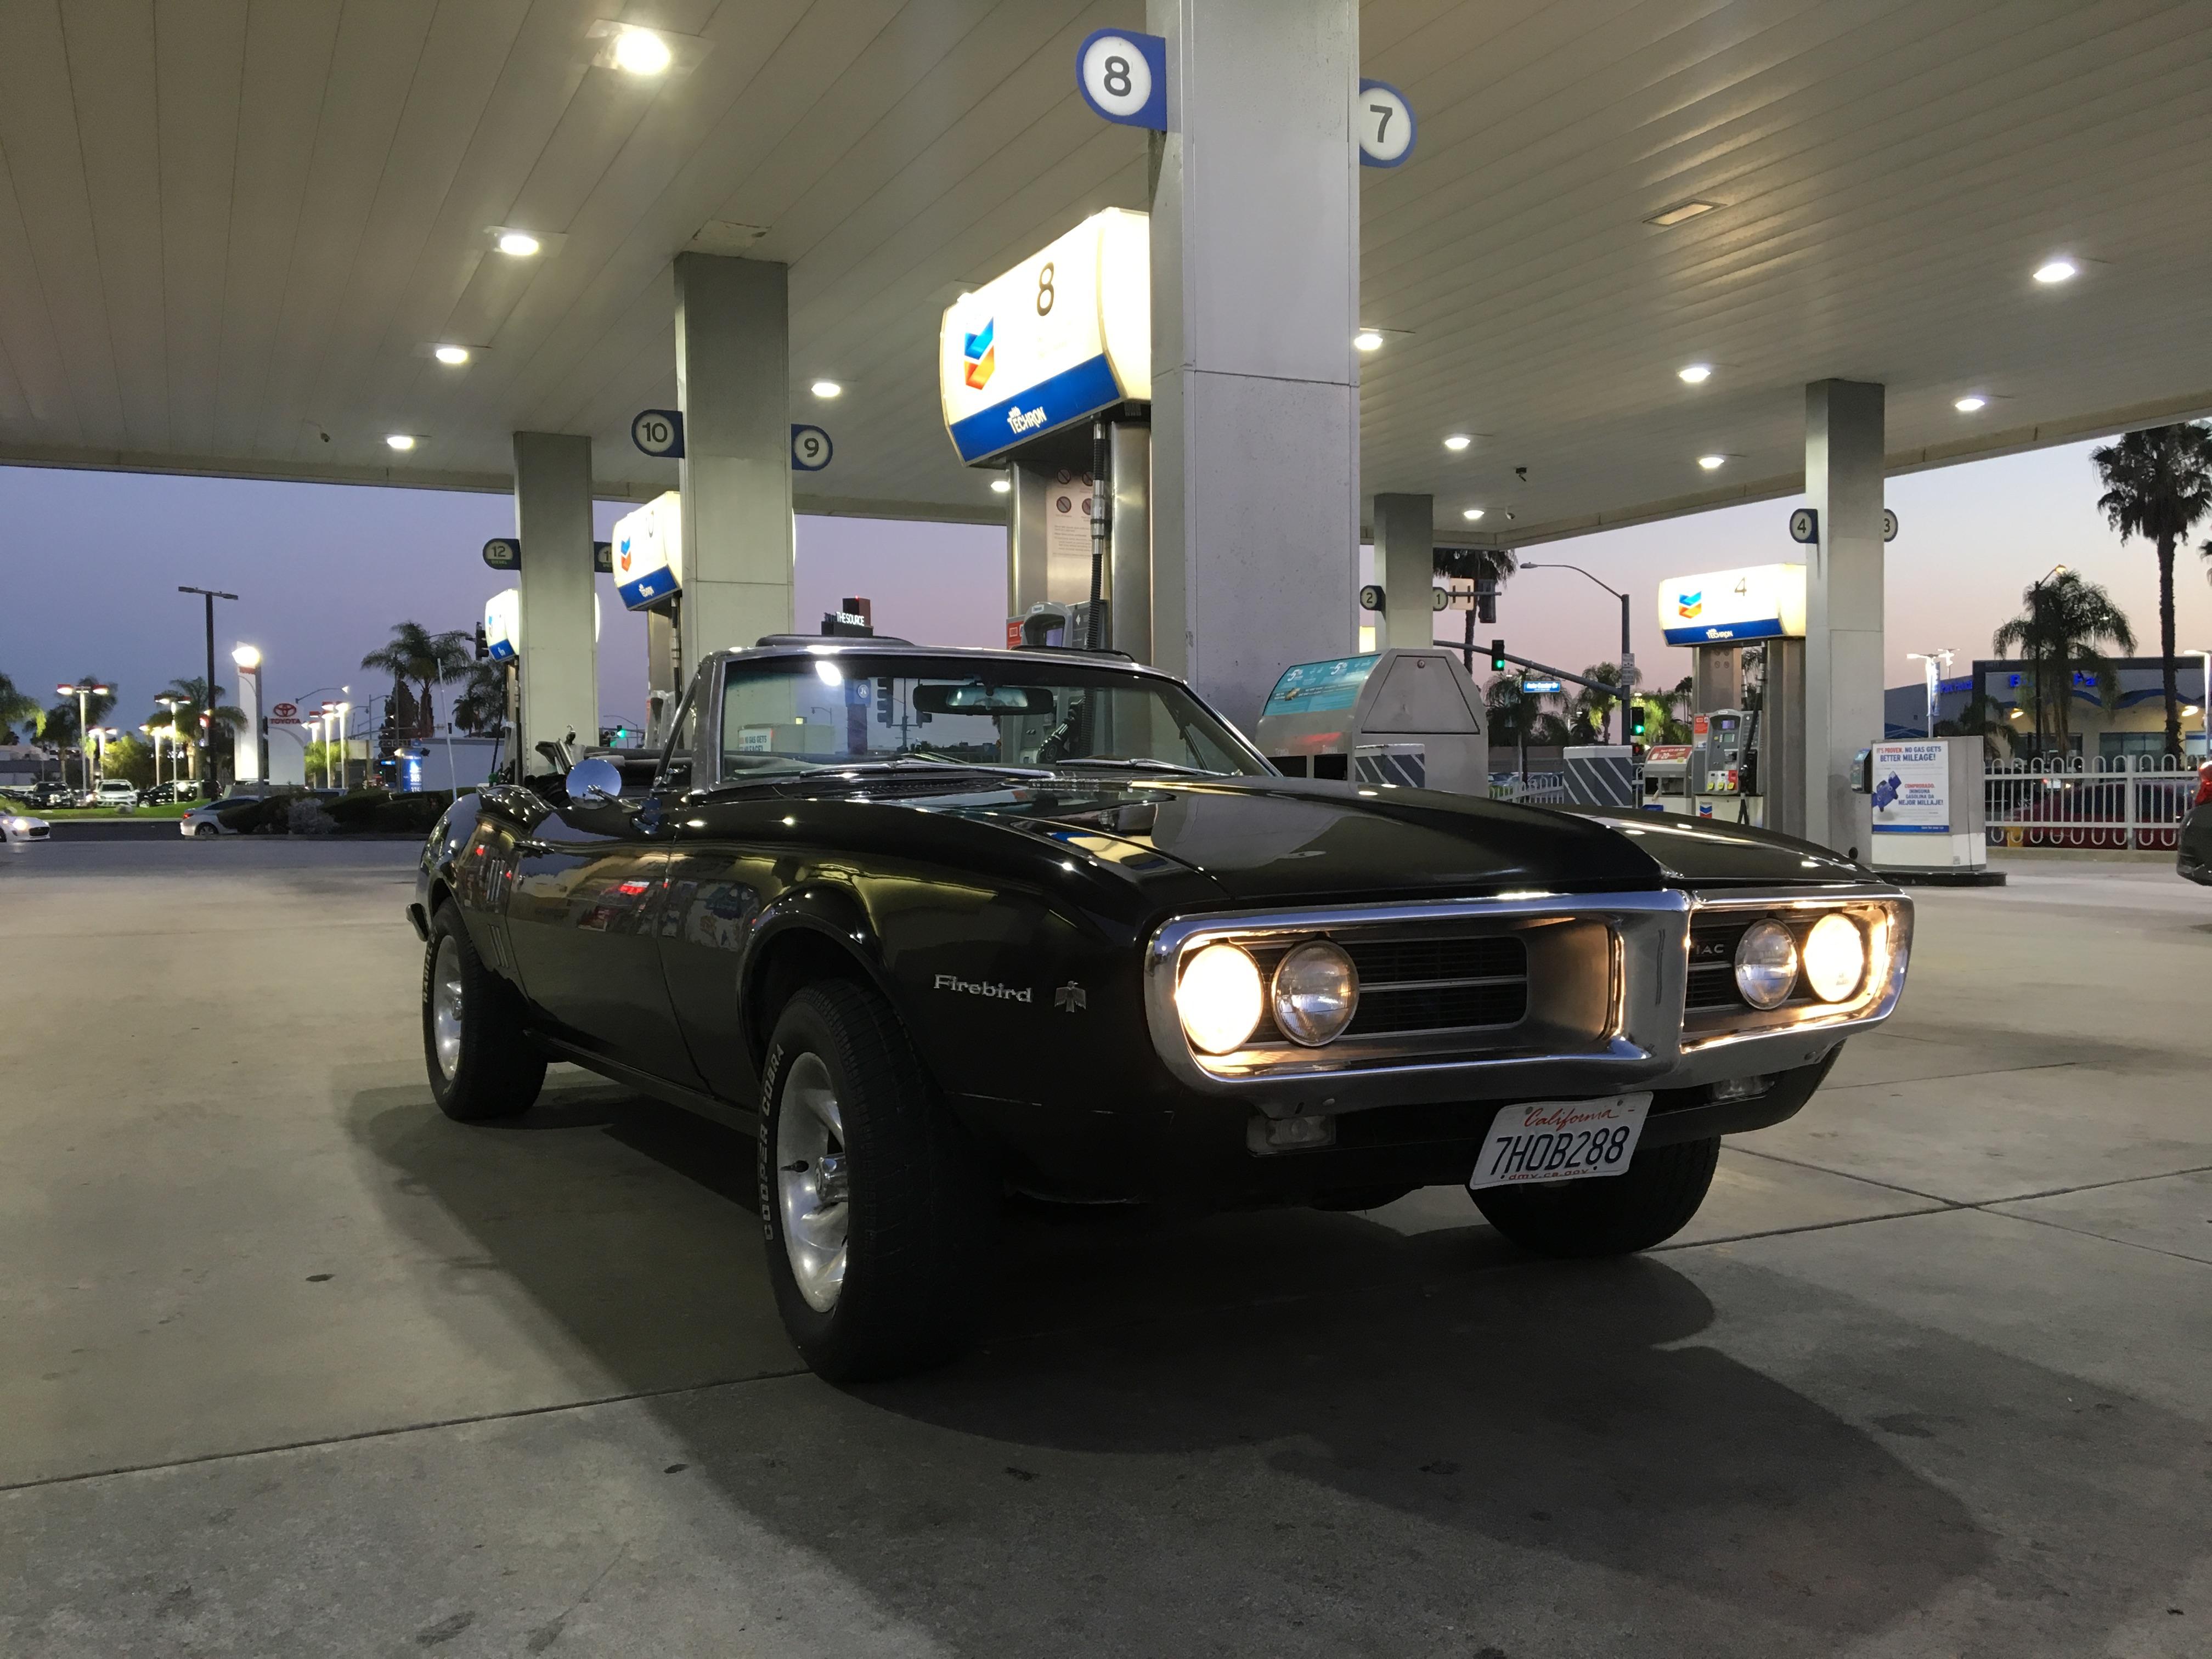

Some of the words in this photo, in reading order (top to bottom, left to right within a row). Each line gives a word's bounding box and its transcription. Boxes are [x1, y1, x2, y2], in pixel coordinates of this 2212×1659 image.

[1103, 55, 1132, 97] 8
[1369, 104, 1393, 143] 7
[1036, 262, 1055, 317] 8
[1007, 406, 1047, 434] TECHRON
[642, 422, 668, 443] 10
[804, 438, 819, 458] 9
[1797, 518, 1806, 533] 4
[1884, 518, 1891, 533] 3
[491, 545, 506, 557] 12
[1734, 577, 1747, 596] 4
[1366, 592, 1373, 603] 2
[1436, 594, 1441, 605] 1
[836, 612, 845, 623] THE
[845, 613, 865, 627] SOURCE
[1706, 630, 1734, 639] TECHRON
[934, 974, 1032, 1003] Firebird
[762, 1043, 784, 1116] COBRA
[1524, 1108, 1620, 1131] California
[1490, 1126, 1630, 1175] 7HOB288
[759, 1123, 774, 1240] COOPER
[1509, 1168, 1589, 1180] dmv.ca.gov
